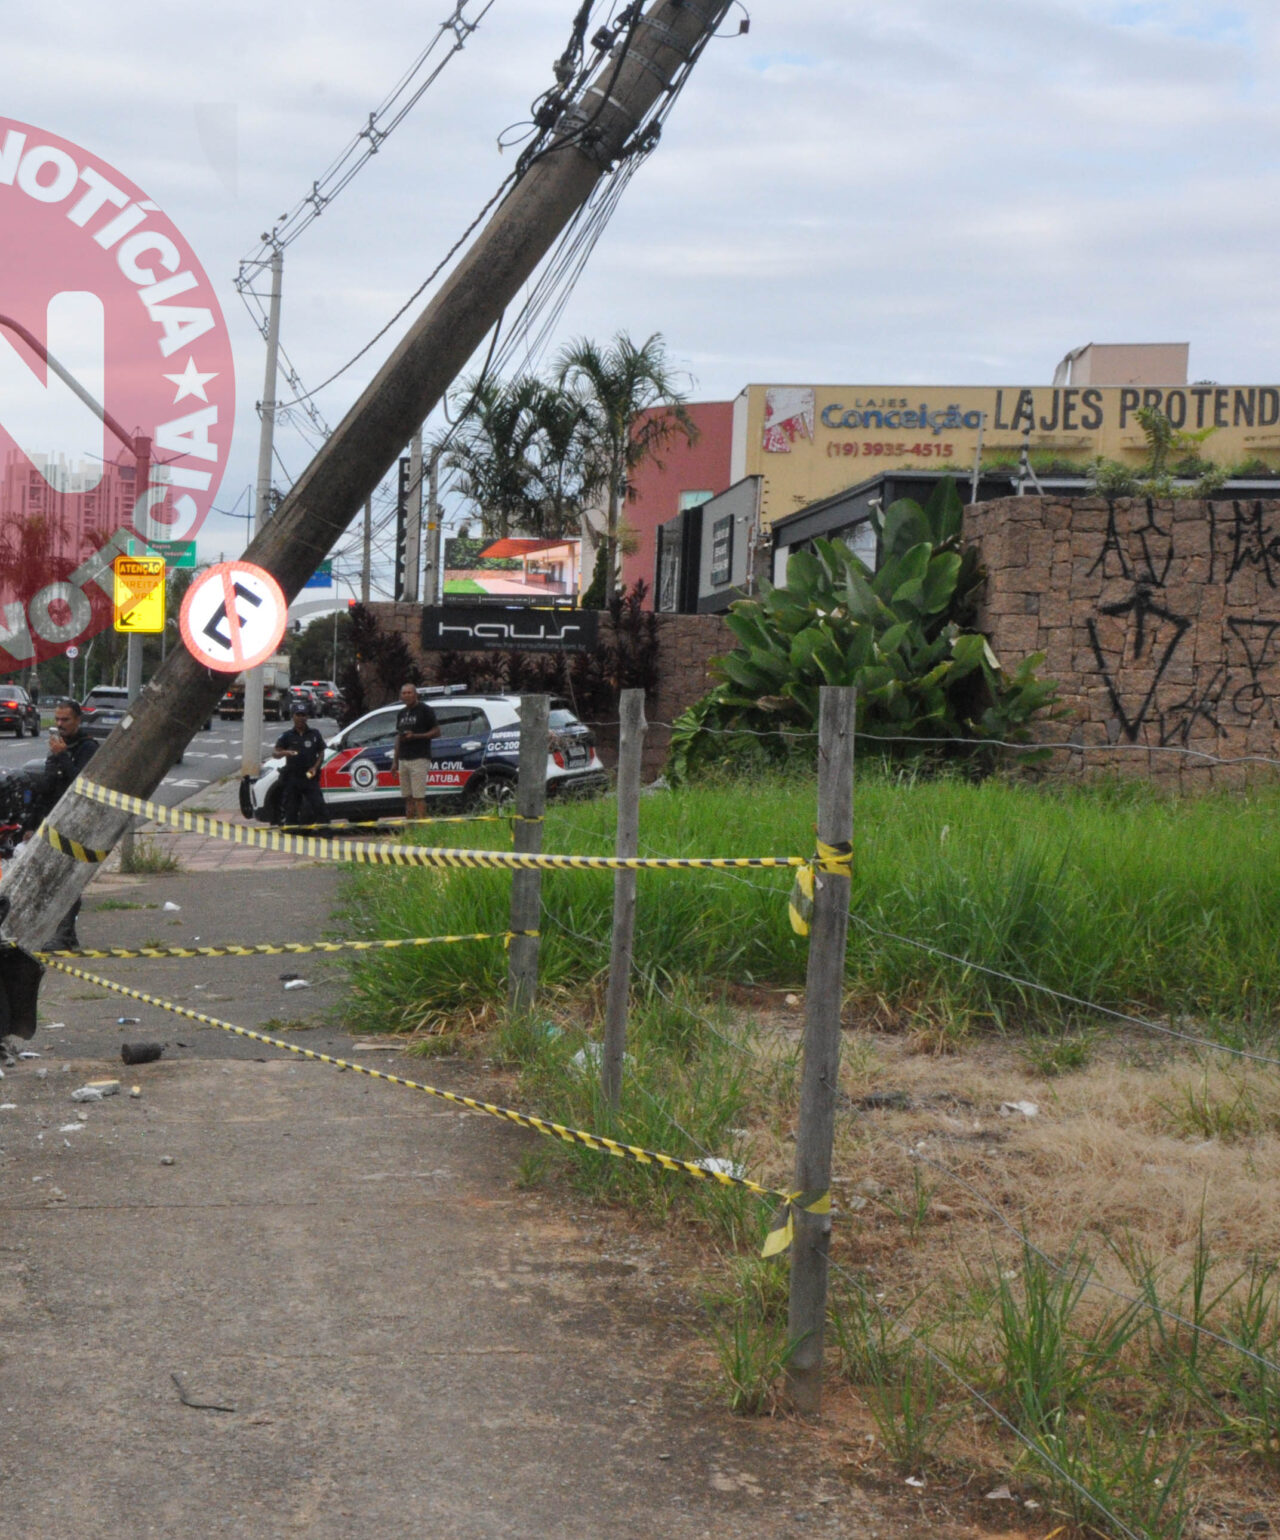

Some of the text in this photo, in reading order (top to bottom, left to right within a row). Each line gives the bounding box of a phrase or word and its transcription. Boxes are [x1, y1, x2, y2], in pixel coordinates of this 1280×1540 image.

[856, 398, 908, 408] LAJES
[994, 389, 1103, 431] LAJES
[821, 403, 983, 435] Conceição
[827, 441, 953, 458] (19) 3935-4515
[120, 561, 161, 575] ATENÇÃO
[441, 761, 465, 770] CIVIL
